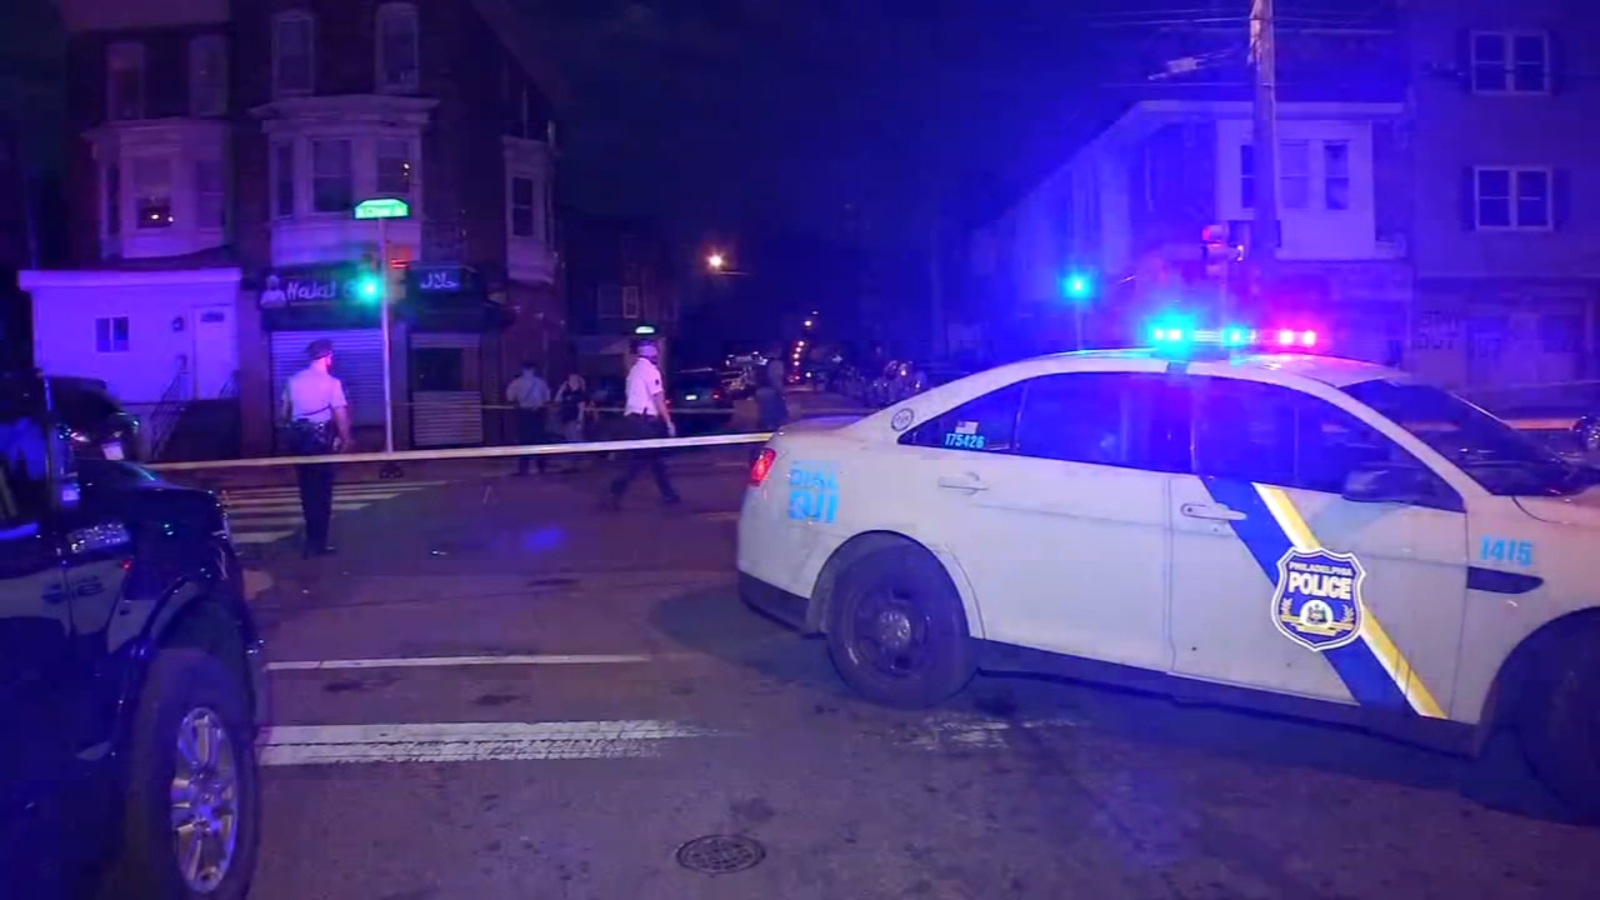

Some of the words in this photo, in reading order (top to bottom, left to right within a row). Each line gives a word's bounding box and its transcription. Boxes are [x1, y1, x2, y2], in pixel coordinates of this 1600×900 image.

[944, 433, 986, 449] 175426
[1479, 535, 1532, 567] 1415
[1288, 571, 1352, 600] POLICE
